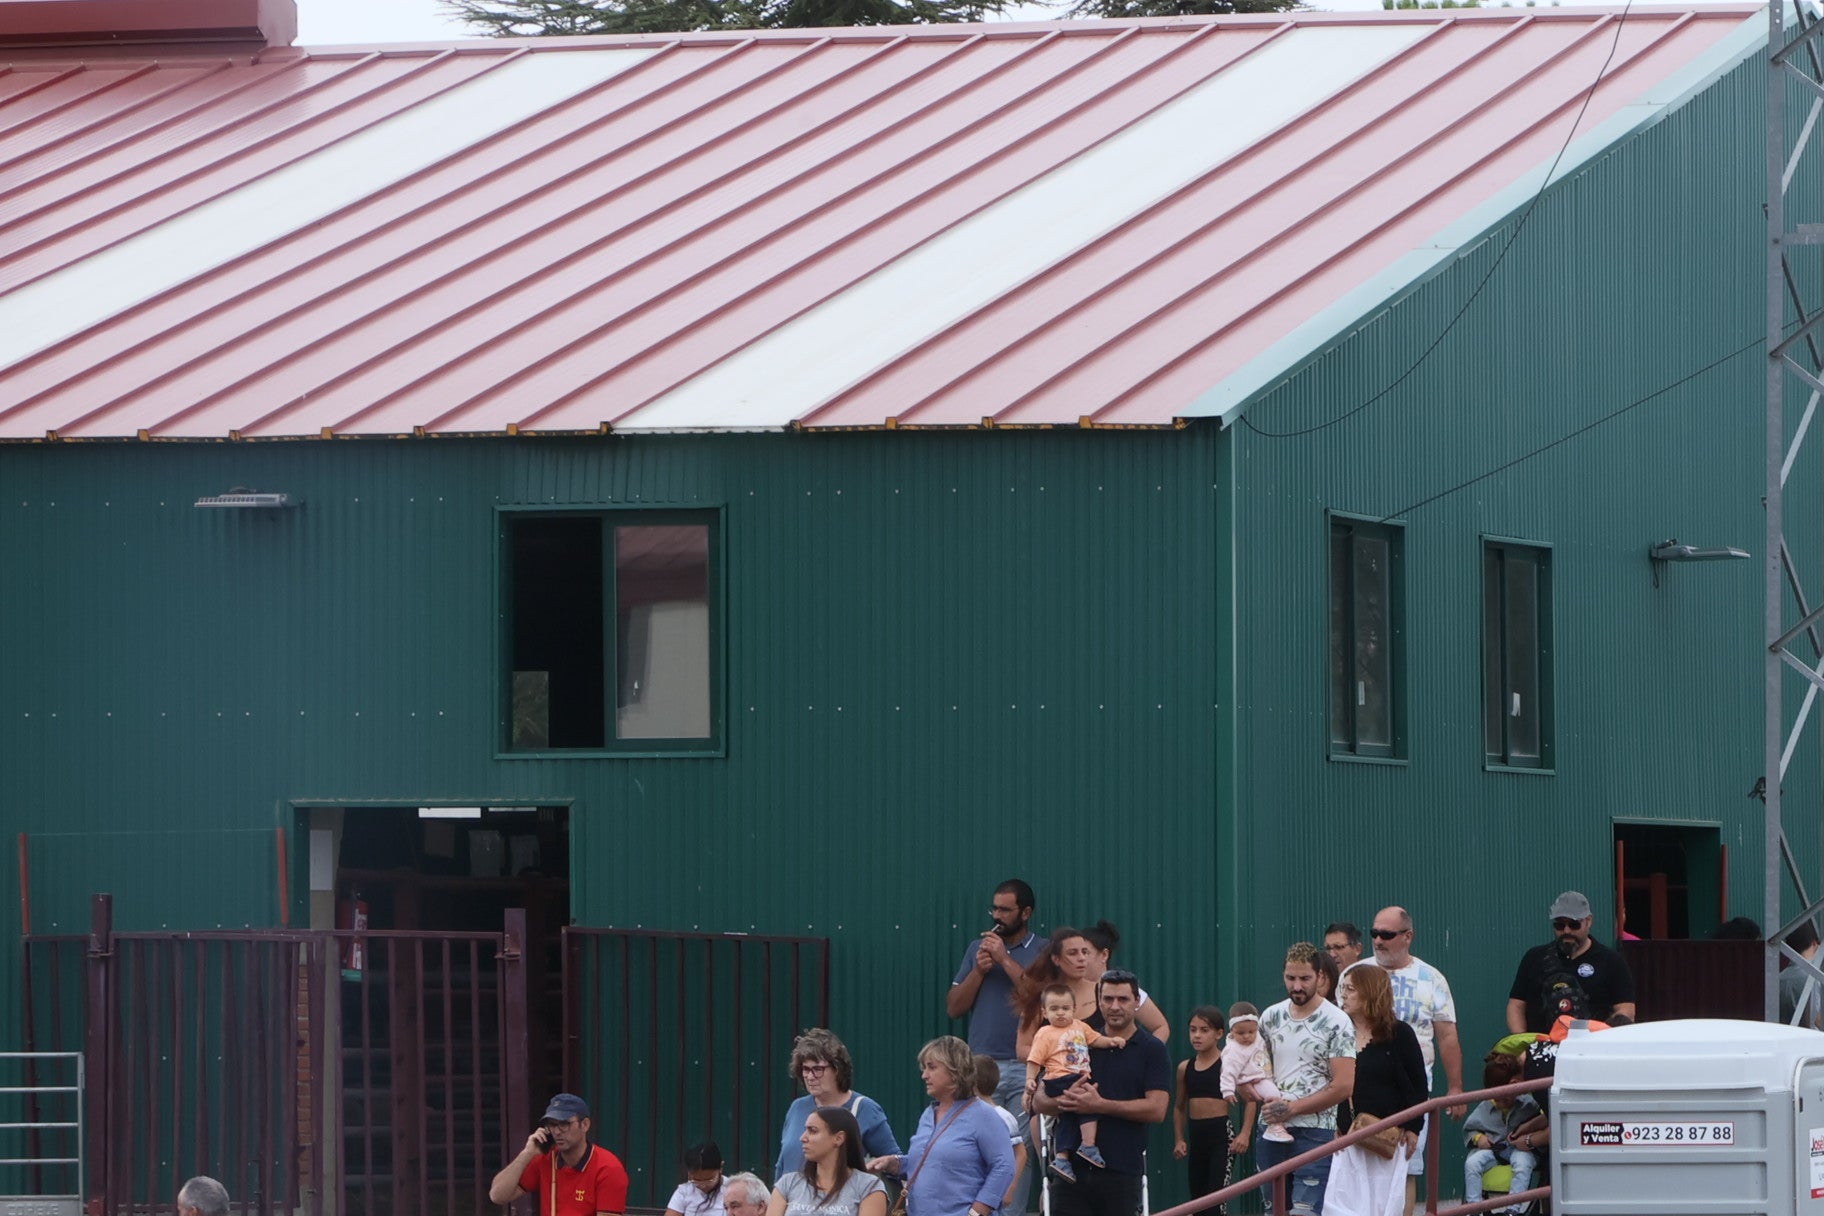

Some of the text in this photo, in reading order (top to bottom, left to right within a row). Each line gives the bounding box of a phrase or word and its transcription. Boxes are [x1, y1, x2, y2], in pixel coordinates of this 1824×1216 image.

[1583, 1124, 1620, 1133] Alquiler
[1632, 1127, 1732, 1140] 923 28 87 88
[1583, 1134, 1620, 1143] y Venta
